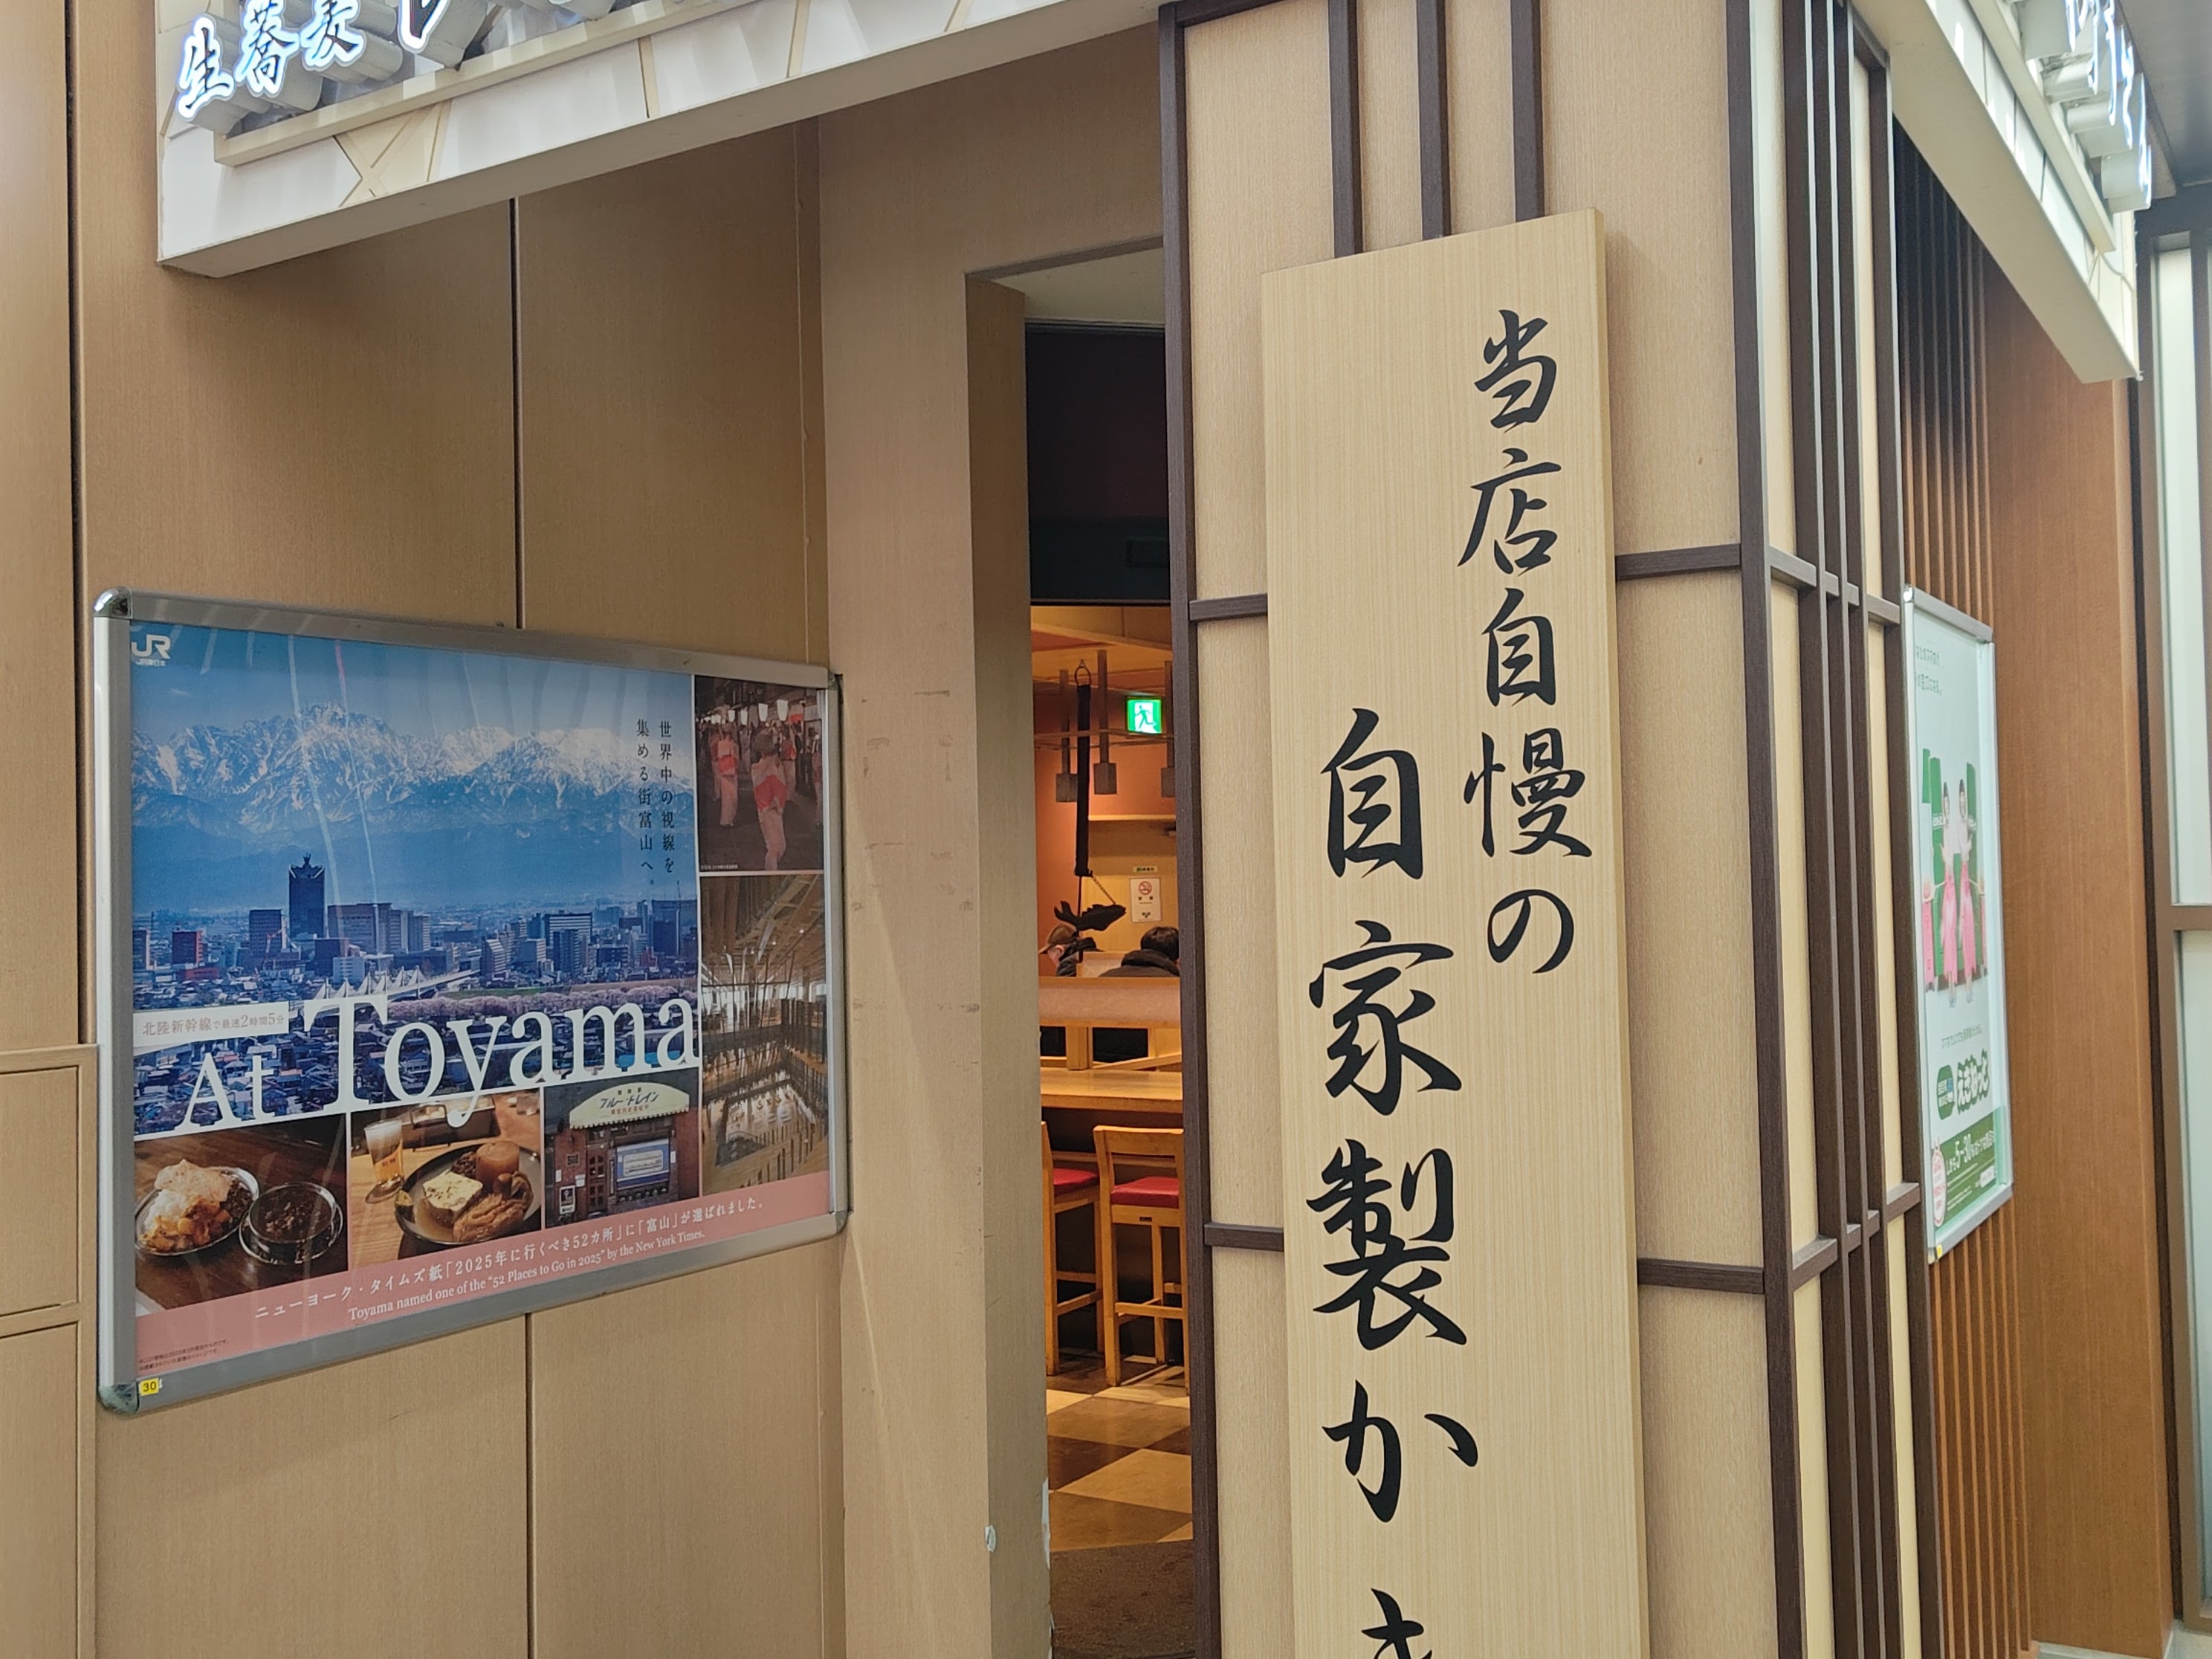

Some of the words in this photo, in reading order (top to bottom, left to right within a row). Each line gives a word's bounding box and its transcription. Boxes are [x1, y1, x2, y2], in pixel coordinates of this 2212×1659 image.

[131, 634, 171, 659] JR
[1456, 308, 1594, 974] 当店自慢の
[636, 718, 655, 885] 集める街富山へ。
[659, 719, 676, 873] 世界中の視線を
[142, 1012, 284, 1036] 北陸新幹線で最速2時間5分
[174, 1052, 277, 1130] At
[304, 994, 700, 1128] Toyama
[348, 1301, 394, 1322] Toyama
[397, 1290, 433, 1310] named
[436, 1289, 454, 1299] one
[456, 1283, 468, 1295] of
[469, 1278, 486, 1293] the
[508, 1267, 537, 1282] Places
[539, 1264, 550, 1275] to
[551, 1261, 565, 1272] Go
[566, 1258, 577, 1269] in
[607, 1248, 618, 1261] by
[619, 1245, 635, 1256] the
[635, 1239, 656, 1254] New
[656, 1234, 677, 1248] York
[677, 1228, 706, 1244] Times.
[143, 1381, 157, 1392] 30
